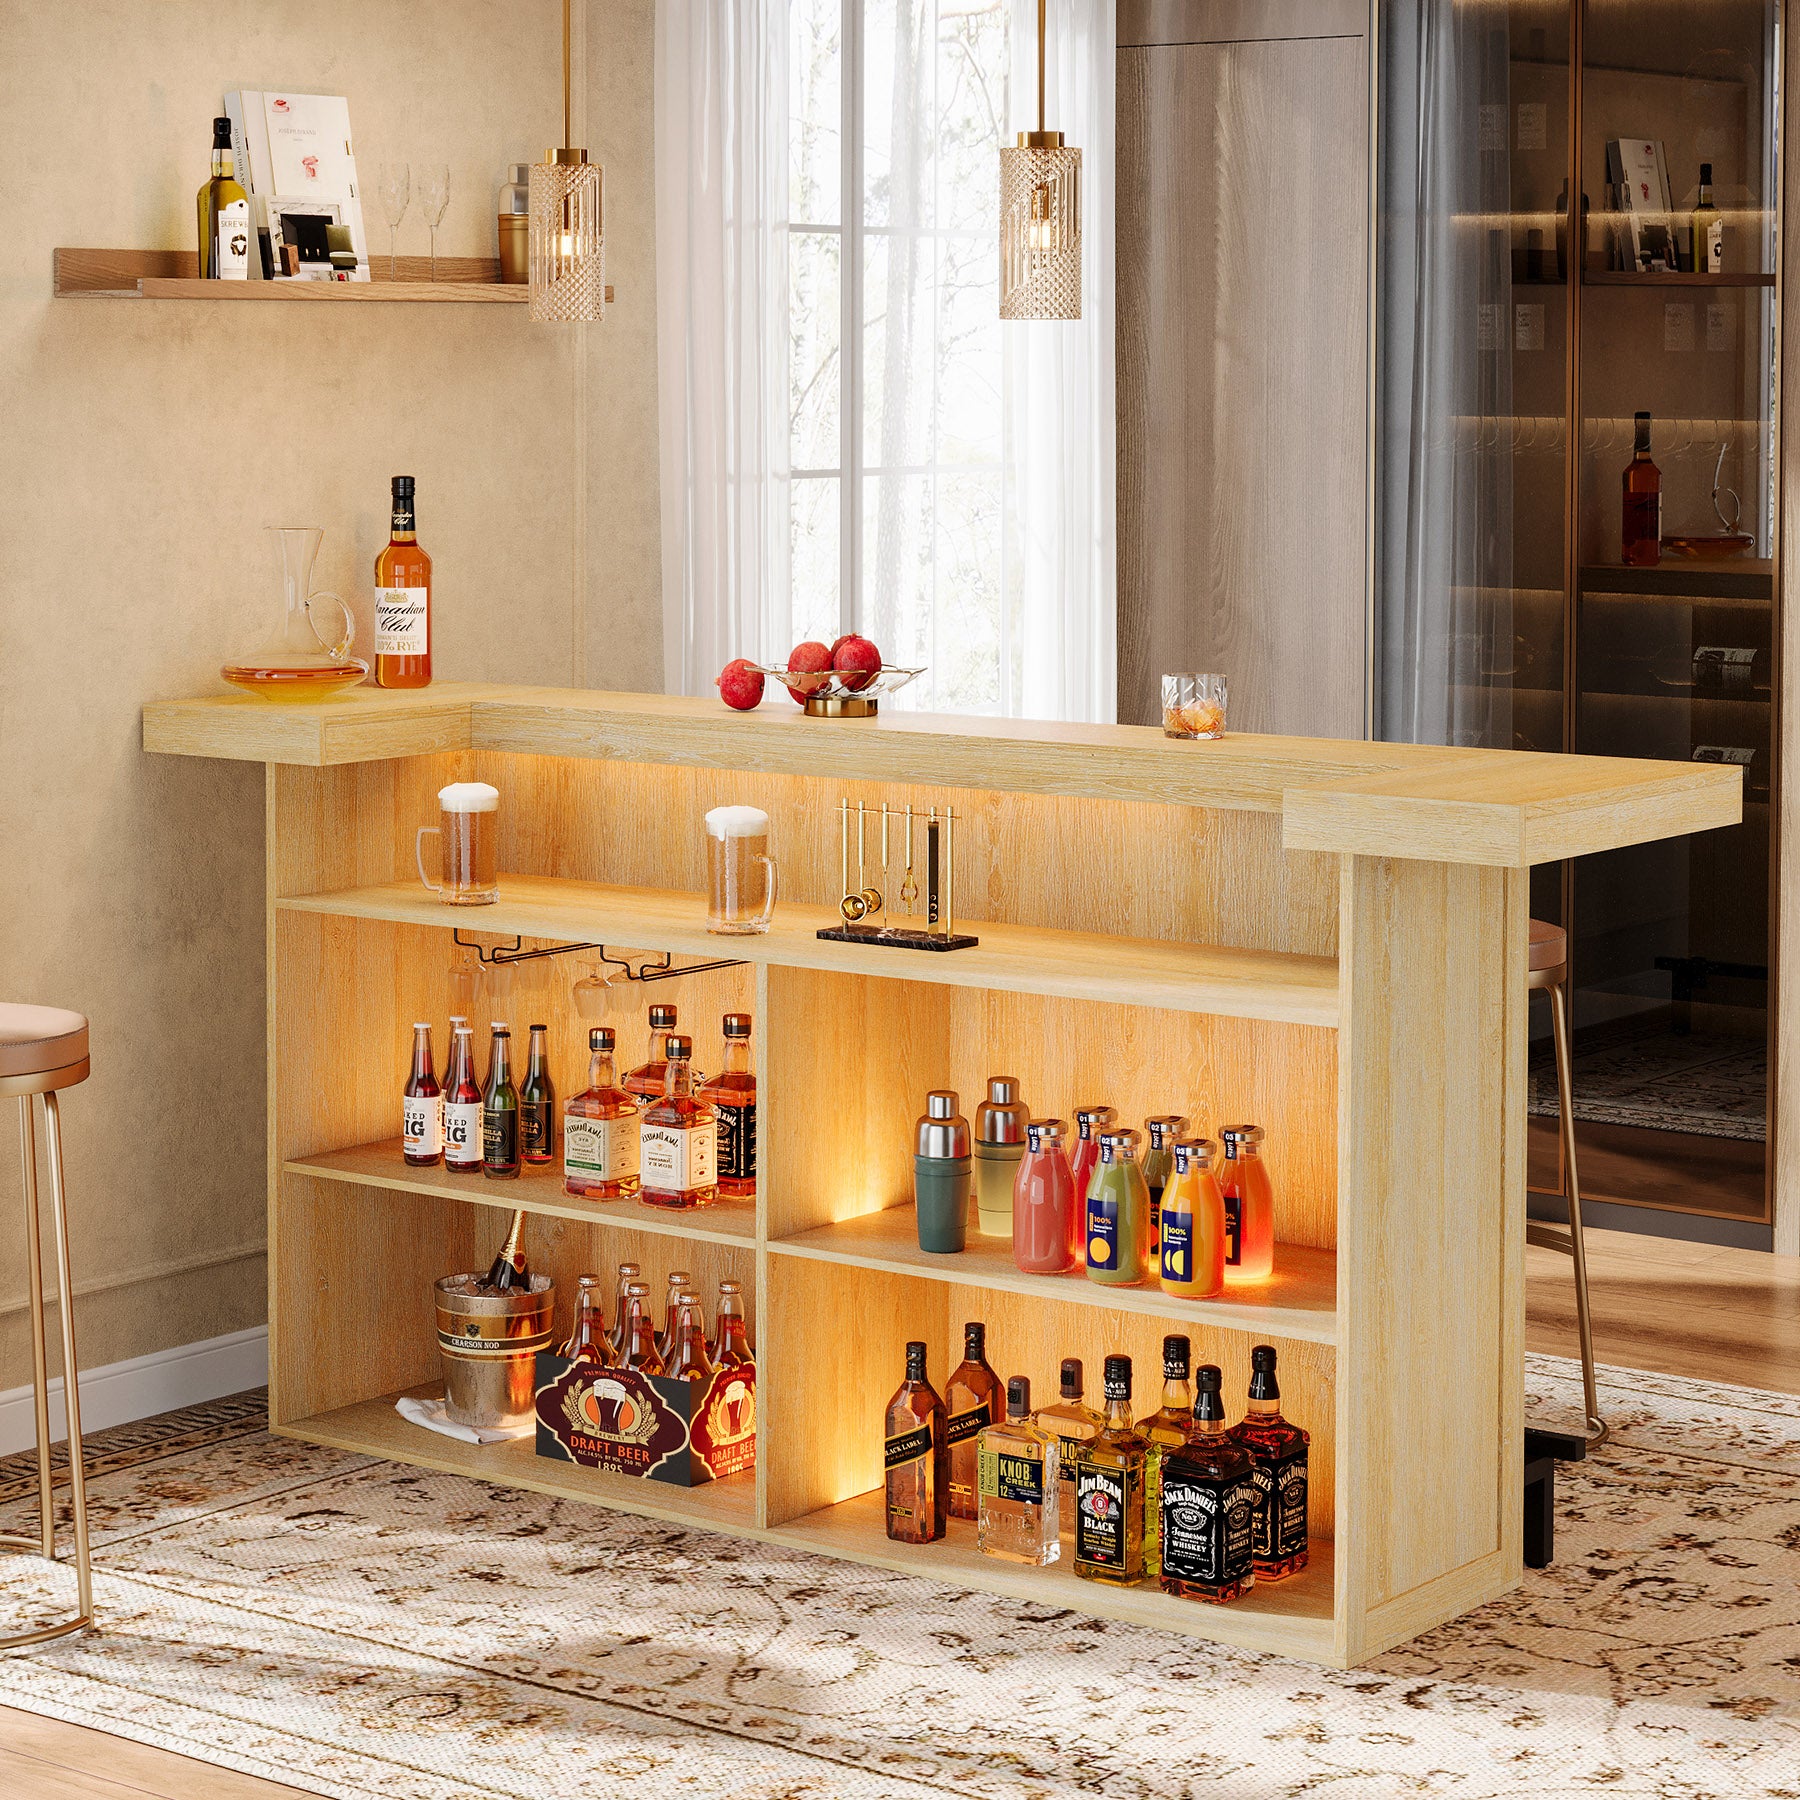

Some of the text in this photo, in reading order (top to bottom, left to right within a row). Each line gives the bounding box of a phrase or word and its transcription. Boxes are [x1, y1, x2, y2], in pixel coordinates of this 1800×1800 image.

[1094, 1216, 1112, 1225] 100%
[1168, 1226, 1187, 1236] 100%
[483, 1342, 500, 1350] NOD
[1163, 1360, 1185, 1369] LACK
[1103, 1380, 1127, 1389] LACK
[570, 1435, 651, 1463] DRAFT BEER
[711, 1445, 738, 1465] DRAFT
[885, 1445, 902, 1456] LACK
[1000, 1459, 1030, 1481] KNOB
[1005, 1477, 1037, 1489] CREEK
[1078, 1474, 1122, 1505] JIM BEAM
[1000, 1484, 1009, 1497] 12
[1164, 1487, 1219, 1516] JACK DANIEL'S
[1083, 1516, 1116, 1534] BLACK
[1171, 1526, 1208, 1542] Tennessee
[1172, 1540, 1207, 1553] WHISKEY
